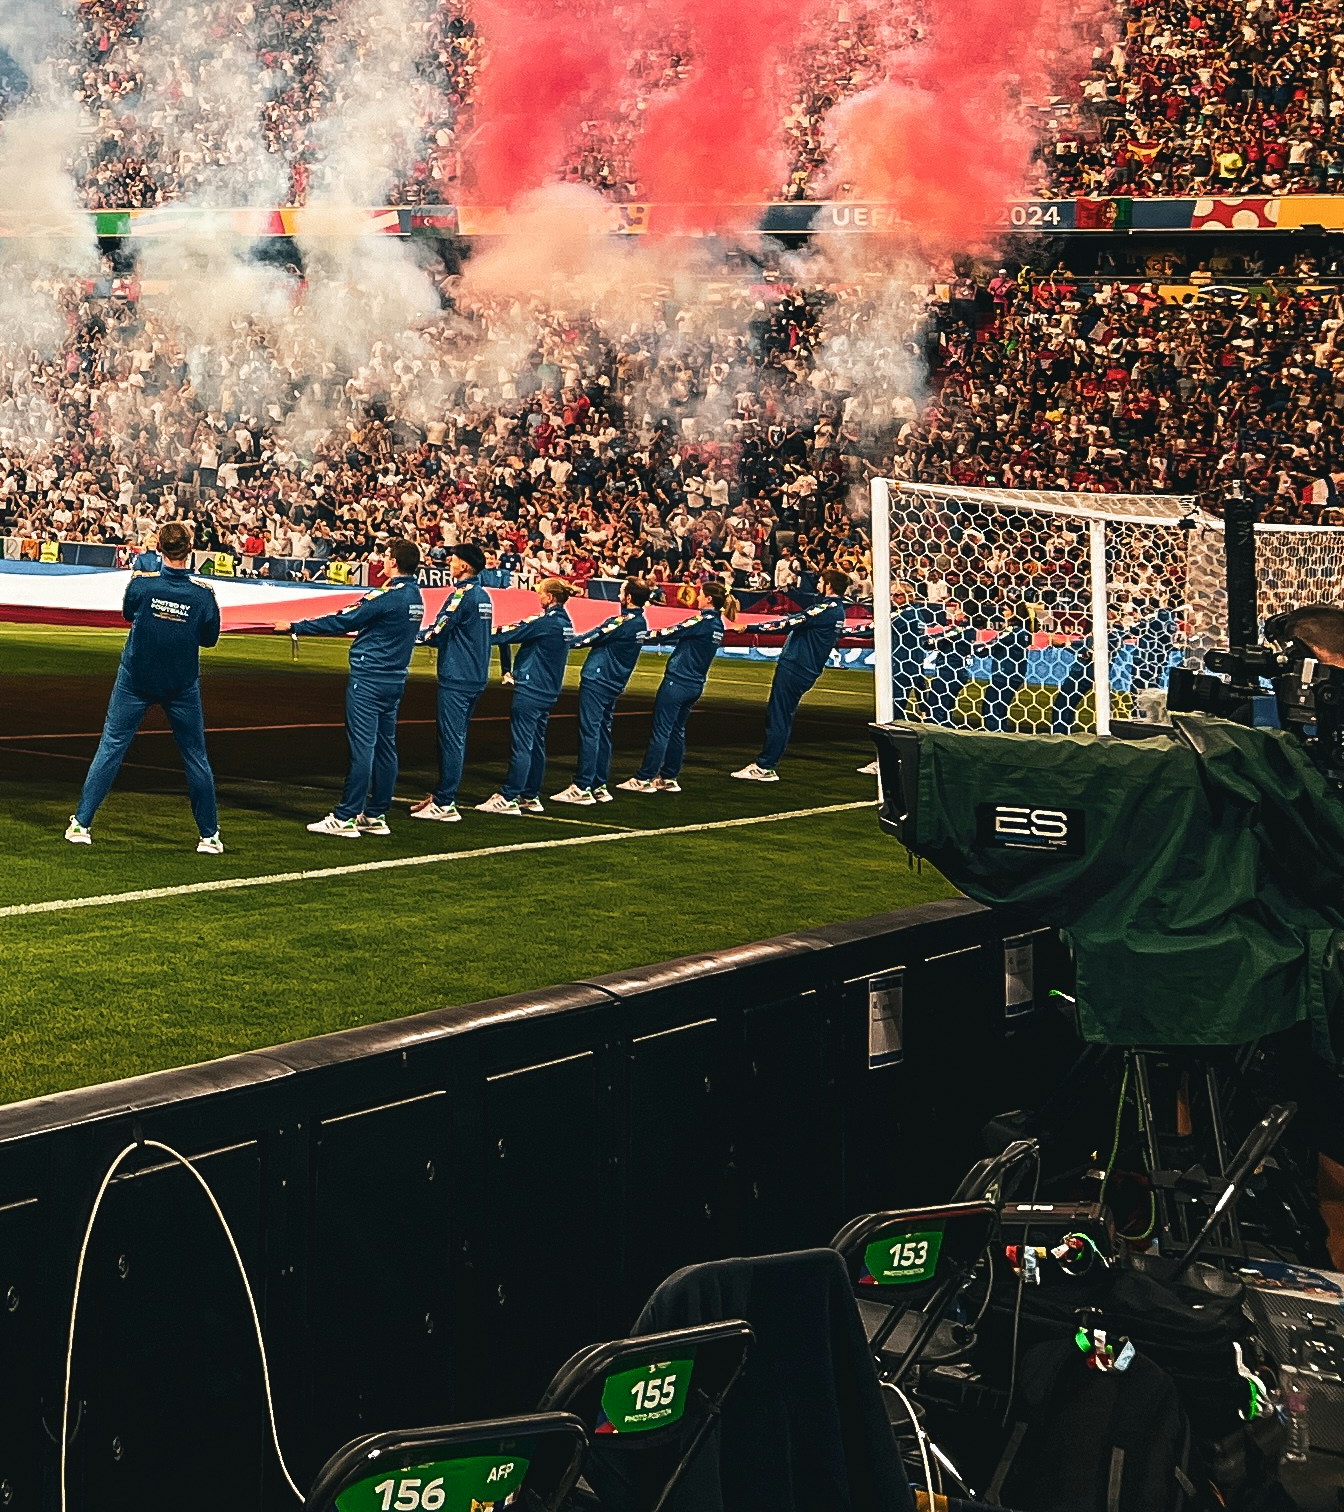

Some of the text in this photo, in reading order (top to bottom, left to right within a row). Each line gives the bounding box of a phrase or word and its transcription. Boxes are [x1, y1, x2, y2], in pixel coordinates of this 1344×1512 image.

[995, 806, 1068, 837] ES
[889, 1240, 929, 1267] 153
[630, 1374, 677, 1411] 155
[486, 1462, 515, 1484] AFP
[374, 1477, 446, 1512] 156
